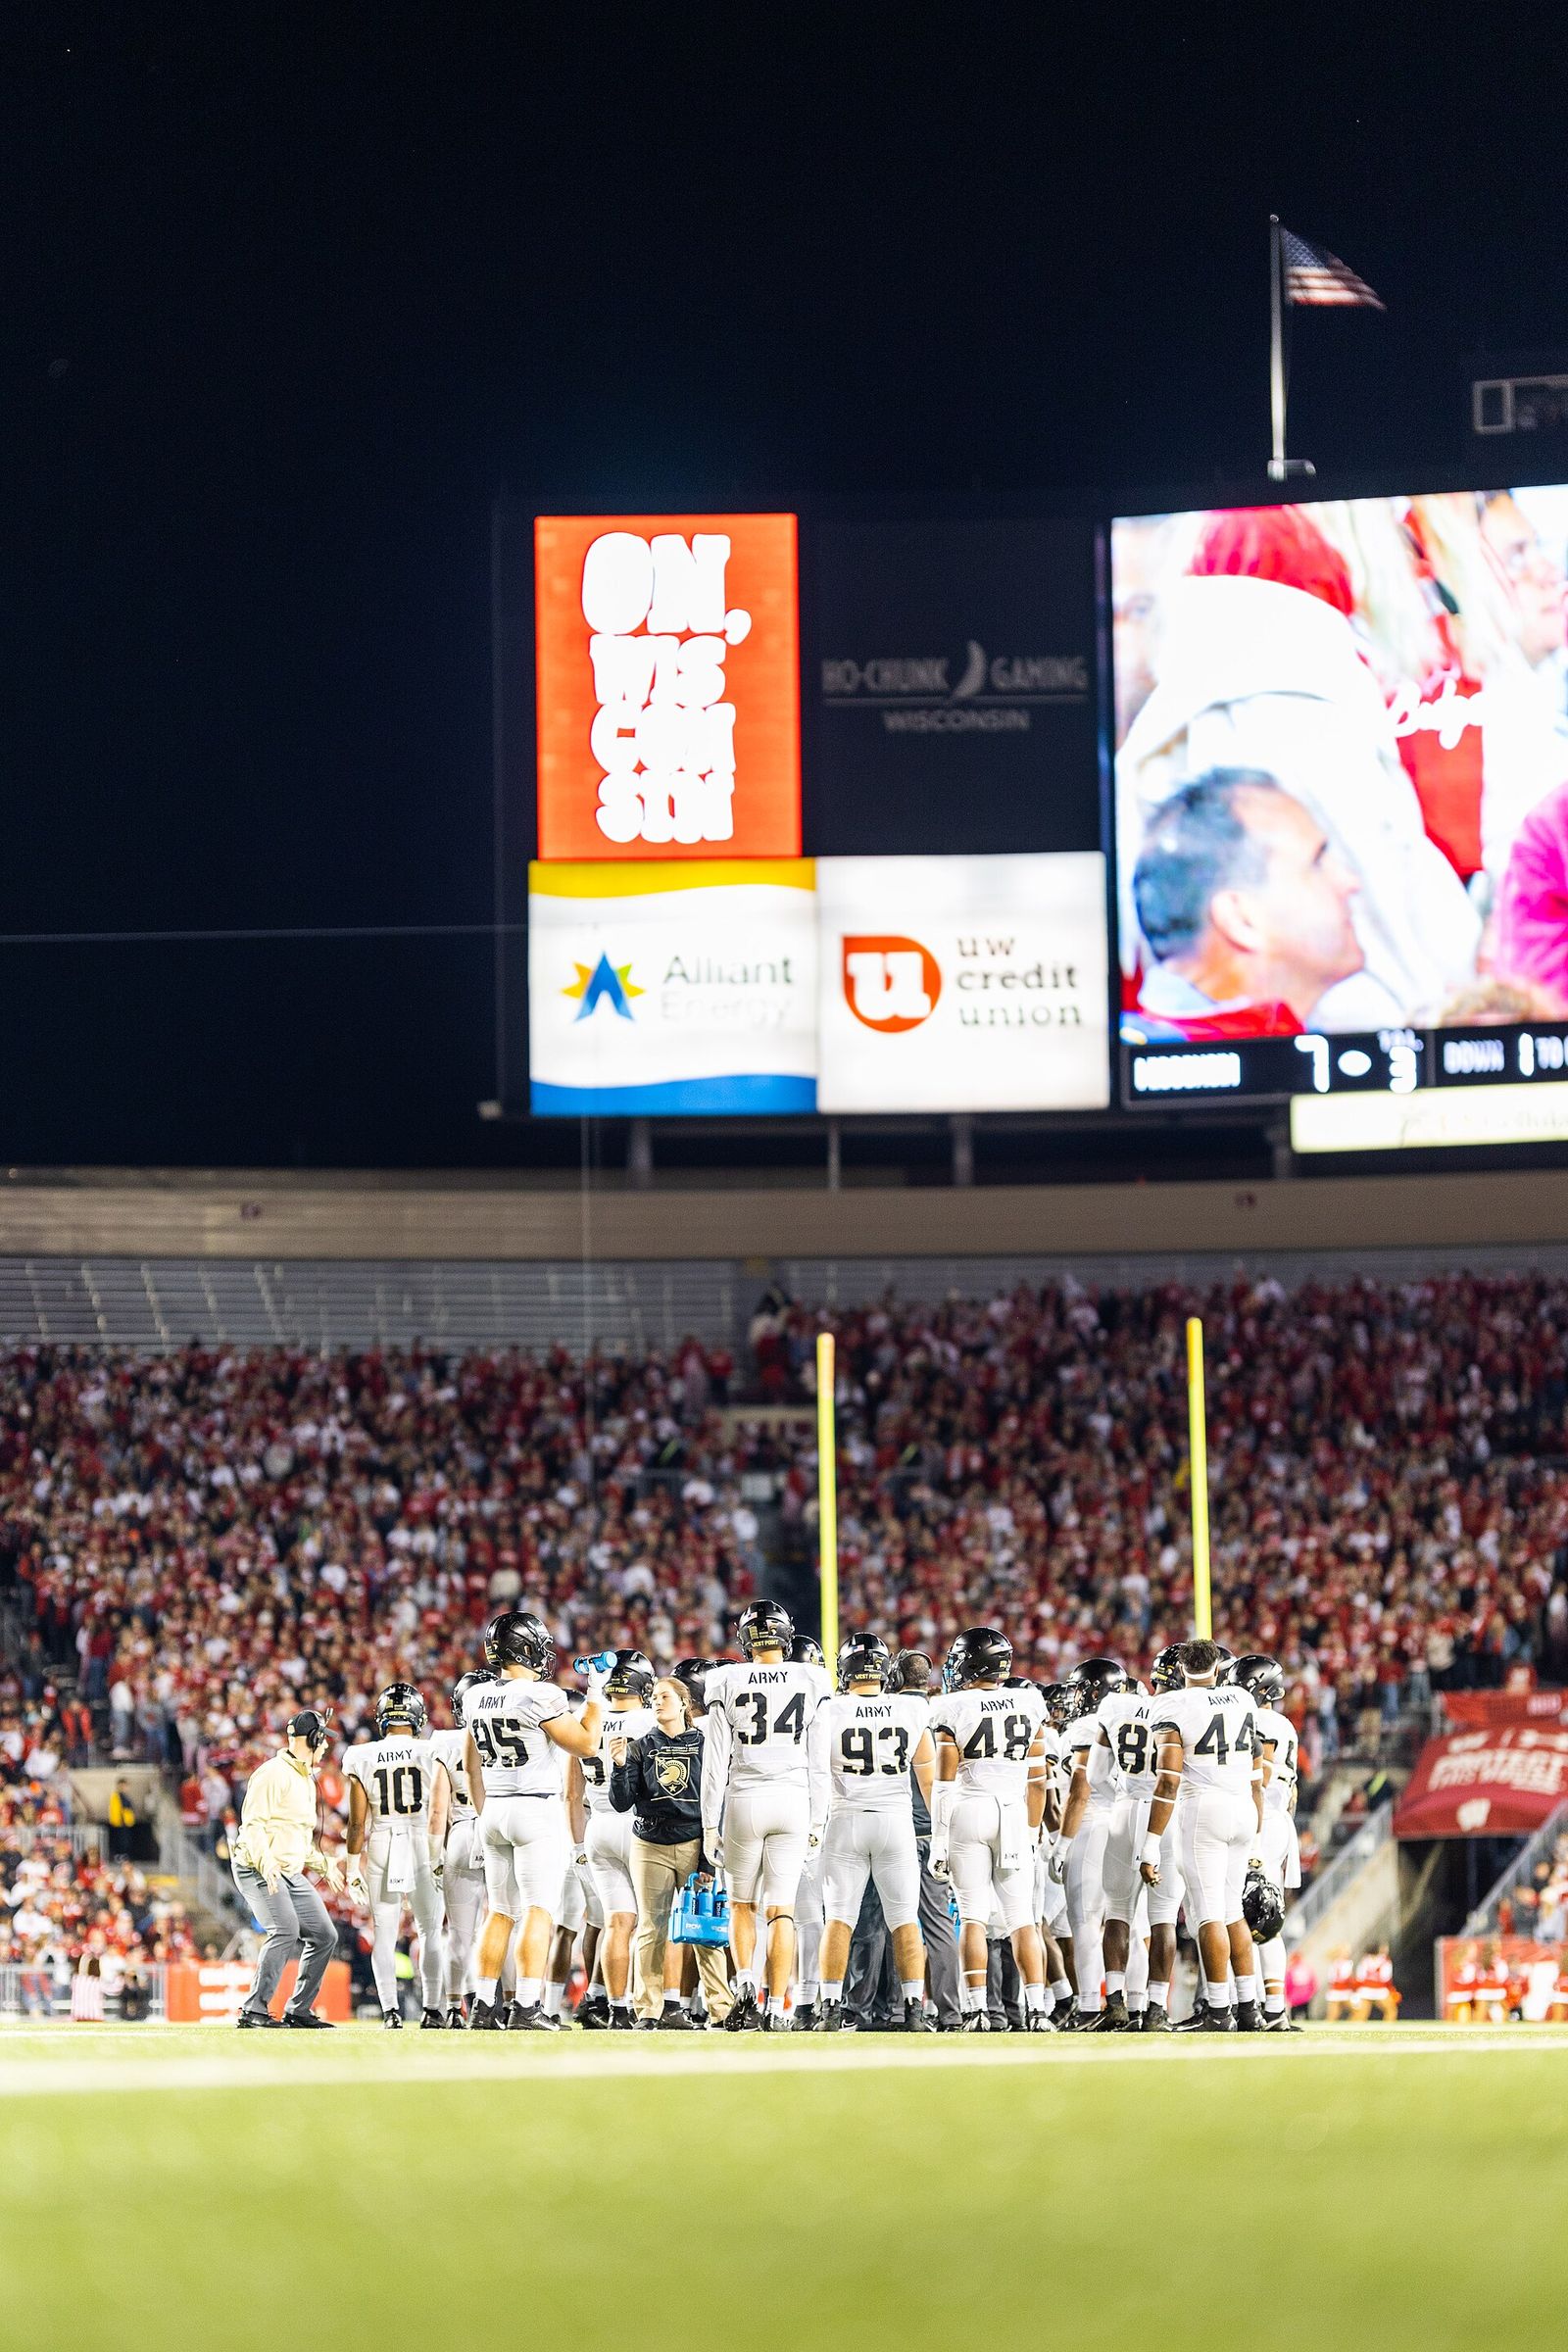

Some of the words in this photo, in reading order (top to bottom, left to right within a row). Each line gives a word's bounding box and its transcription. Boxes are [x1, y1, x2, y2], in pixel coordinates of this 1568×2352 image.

[581, 532, 752, 645] ON,
[589, 634, 726, 706] WIS
[821, 658, 949, 693] HO-CHUNK
[991, 656, 1089, 690] GAMING
[590, 702, 736, 772] CON
[884, 710, 1030, 732] WISCONSIN
[595, 768, 735, 844] SIN
[957, 937, 1015, 956] uw
[663, 955, 792, 985] Alliant
[957, 963, 1077, 990] credit
[959, 1006, 1081, 1026] union
[1295, 1034, 1331, 1093] 7
[1389, 1046, 1418, 1094] 3
[748, 1671, 788, 1685] ARMY
[478, 1695, 507, 1710] ARMY
[856, 1705, 892, 1718] ARMY
[980, 1698, 1015, 1713] ARMY
[1207, 1693, 1240, 1706] ARMY
[603, 1720, 626, 1733] RMY
[735, 1691, 806, 1745] 34
[471, 1718, 529, 1768] 95
[842, 1727, 908, 1777] 93
[963, 1715, 1032, 1761] 48
[1194, 1712, 1255, 1765] 44
[376, 1748, 413, 1763] ARMY
[373, 1766, 422, 1815] 10
